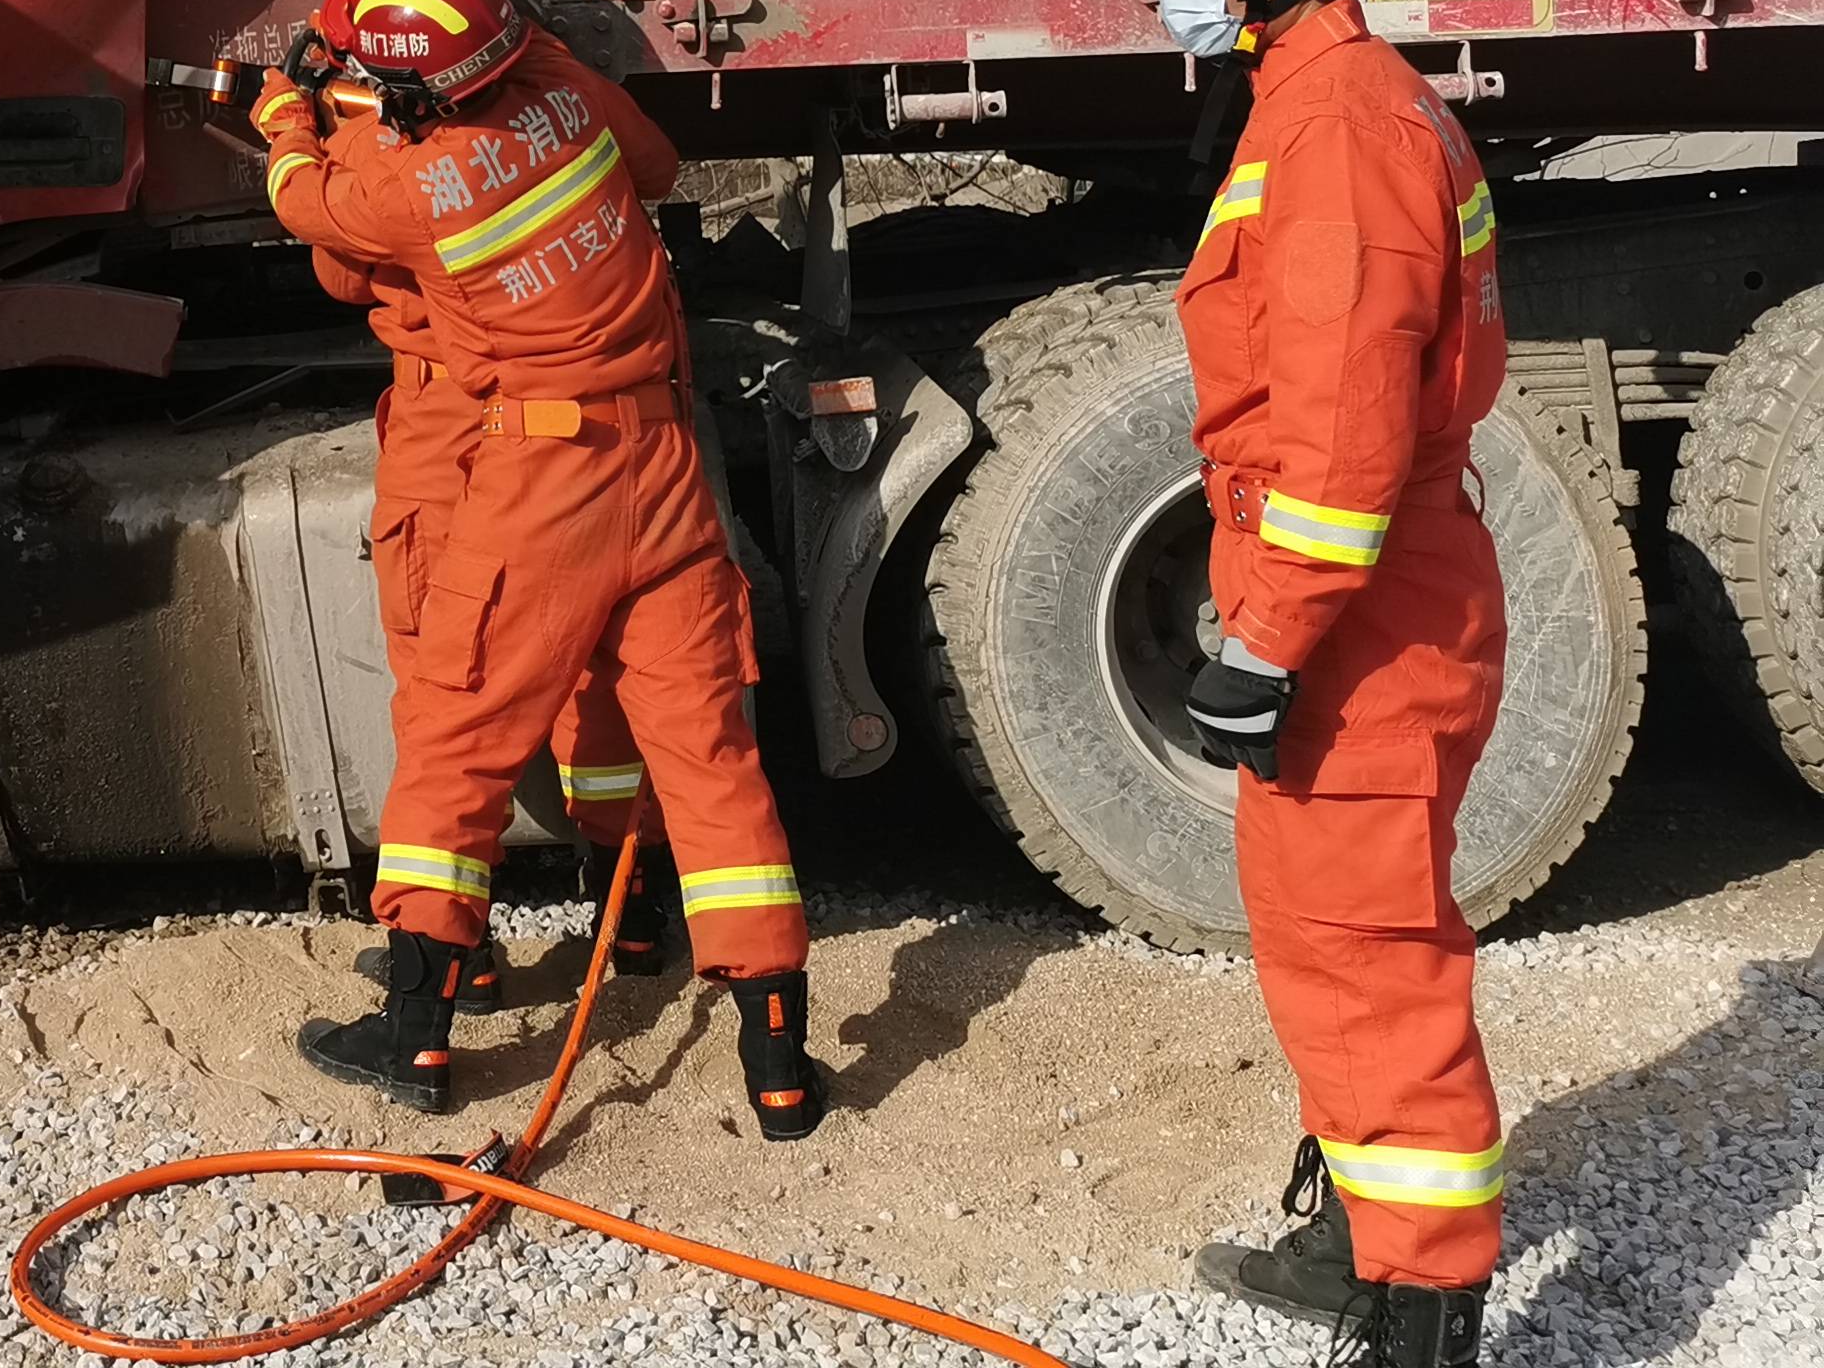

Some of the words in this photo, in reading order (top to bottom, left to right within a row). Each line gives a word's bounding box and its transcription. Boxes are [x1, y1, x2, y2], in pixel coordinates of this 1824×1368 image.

[359, 29, 429, 58] 荆门消防
[434, 51, 491, 87] CHEN
[415, 86, 590, 219] 湖北消防
[496, 199, 627, 304] 荆门支队
